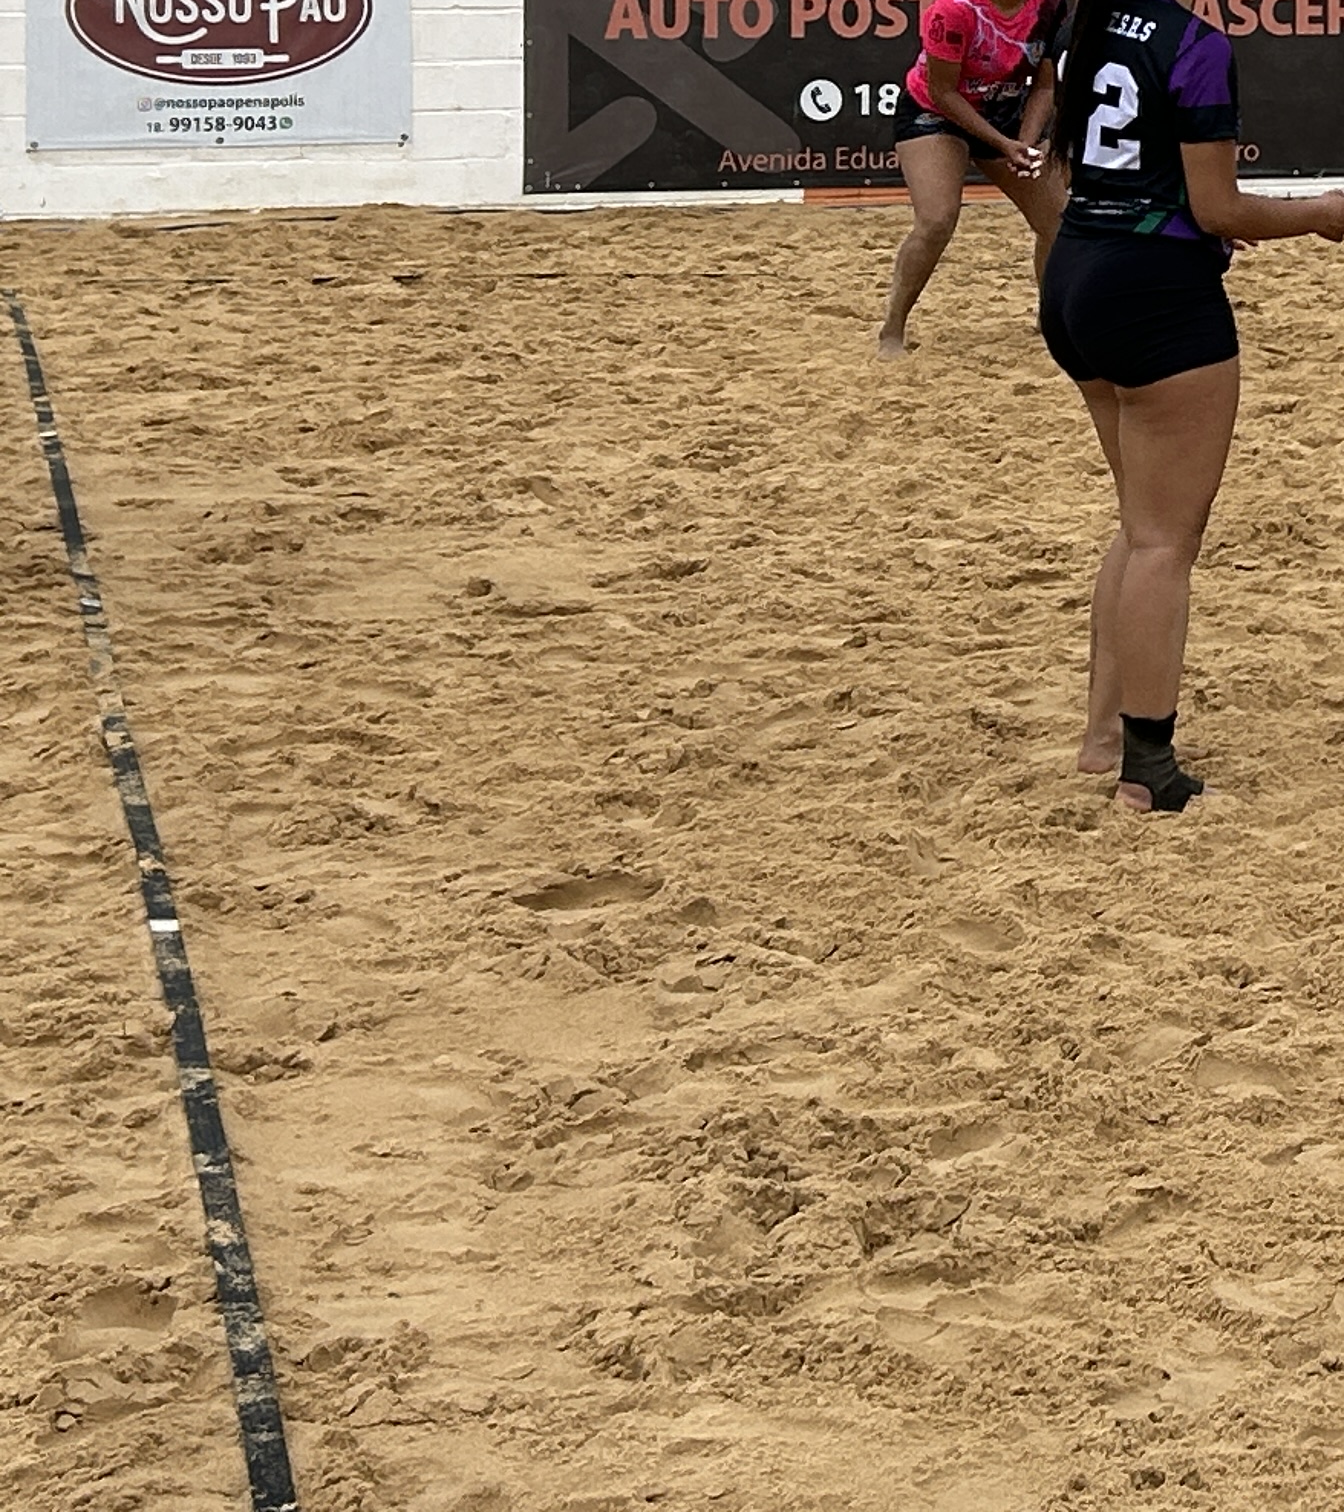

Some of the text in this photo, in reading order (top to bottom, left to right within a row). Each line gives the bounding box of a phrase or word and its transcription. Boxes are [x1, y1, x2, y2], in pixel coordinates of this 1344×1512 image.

[154, 93, 305, 112] @nossopaopenapolis
[168, 115, 278, 133] 99158-9043
[1082, 61, 1141, 170] 2
[717, 145, 900, 173] Avenida Edua
